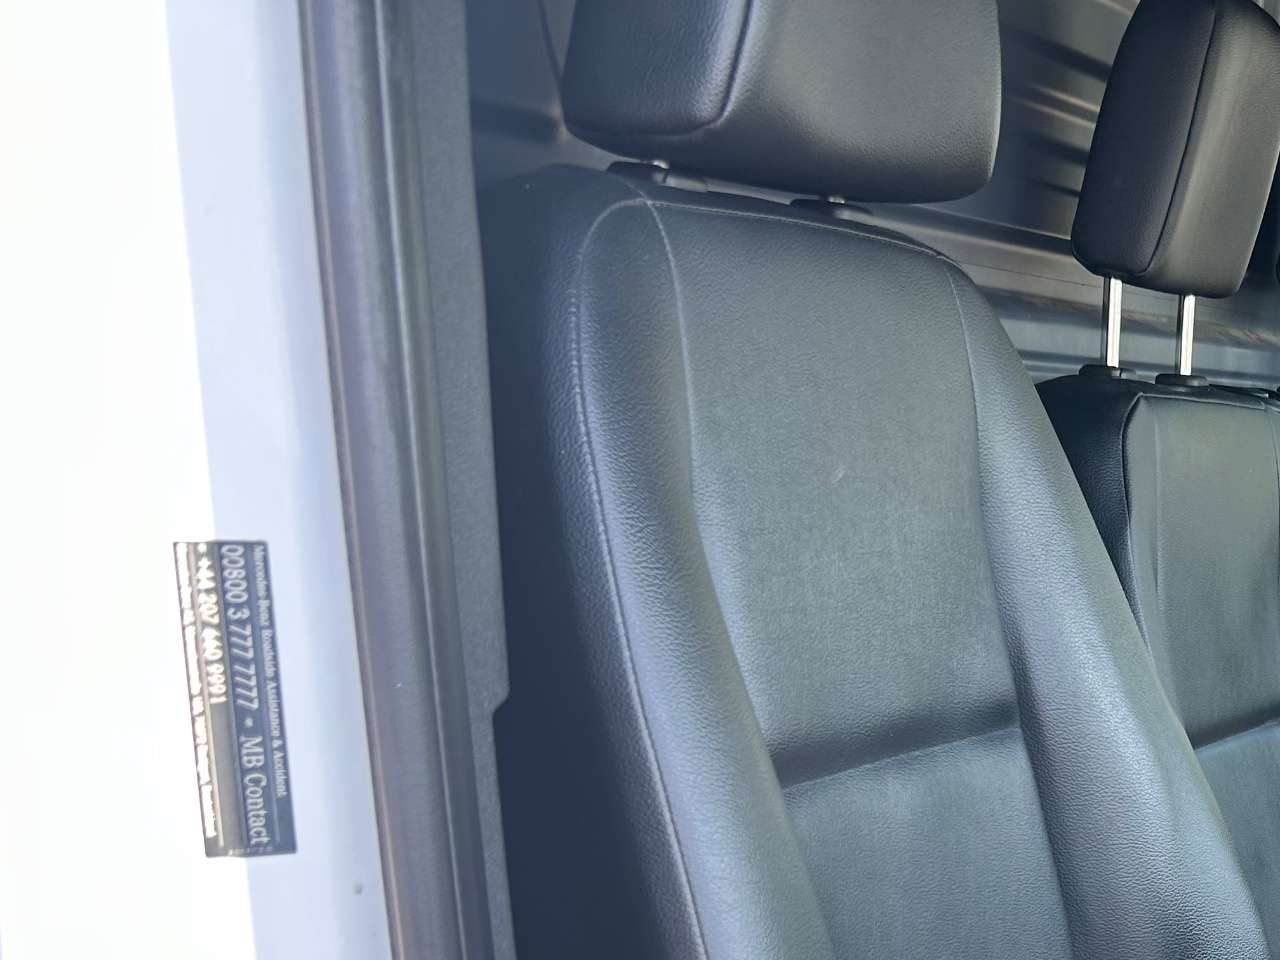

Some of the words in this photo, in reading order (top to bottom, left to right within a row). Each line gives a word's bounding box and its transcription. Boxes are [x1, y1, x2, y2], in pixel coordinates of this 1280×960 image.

[220, 544, 249, 604] 00800
[198, 591, 219, 624] 207
[226, 606, 251, 620] 3
[228, 623, 255, 660] 777
[206, 662, 227, 704] 9991
[233, 663, 259, 711] 7777
[266, 680, 281, 737] Assistance
[240, 735, 266, 768] MB
[271, 739, 284, 749] &
[273, 750, 288, 799] Accident
[244, 774, 271, 846] Contact
